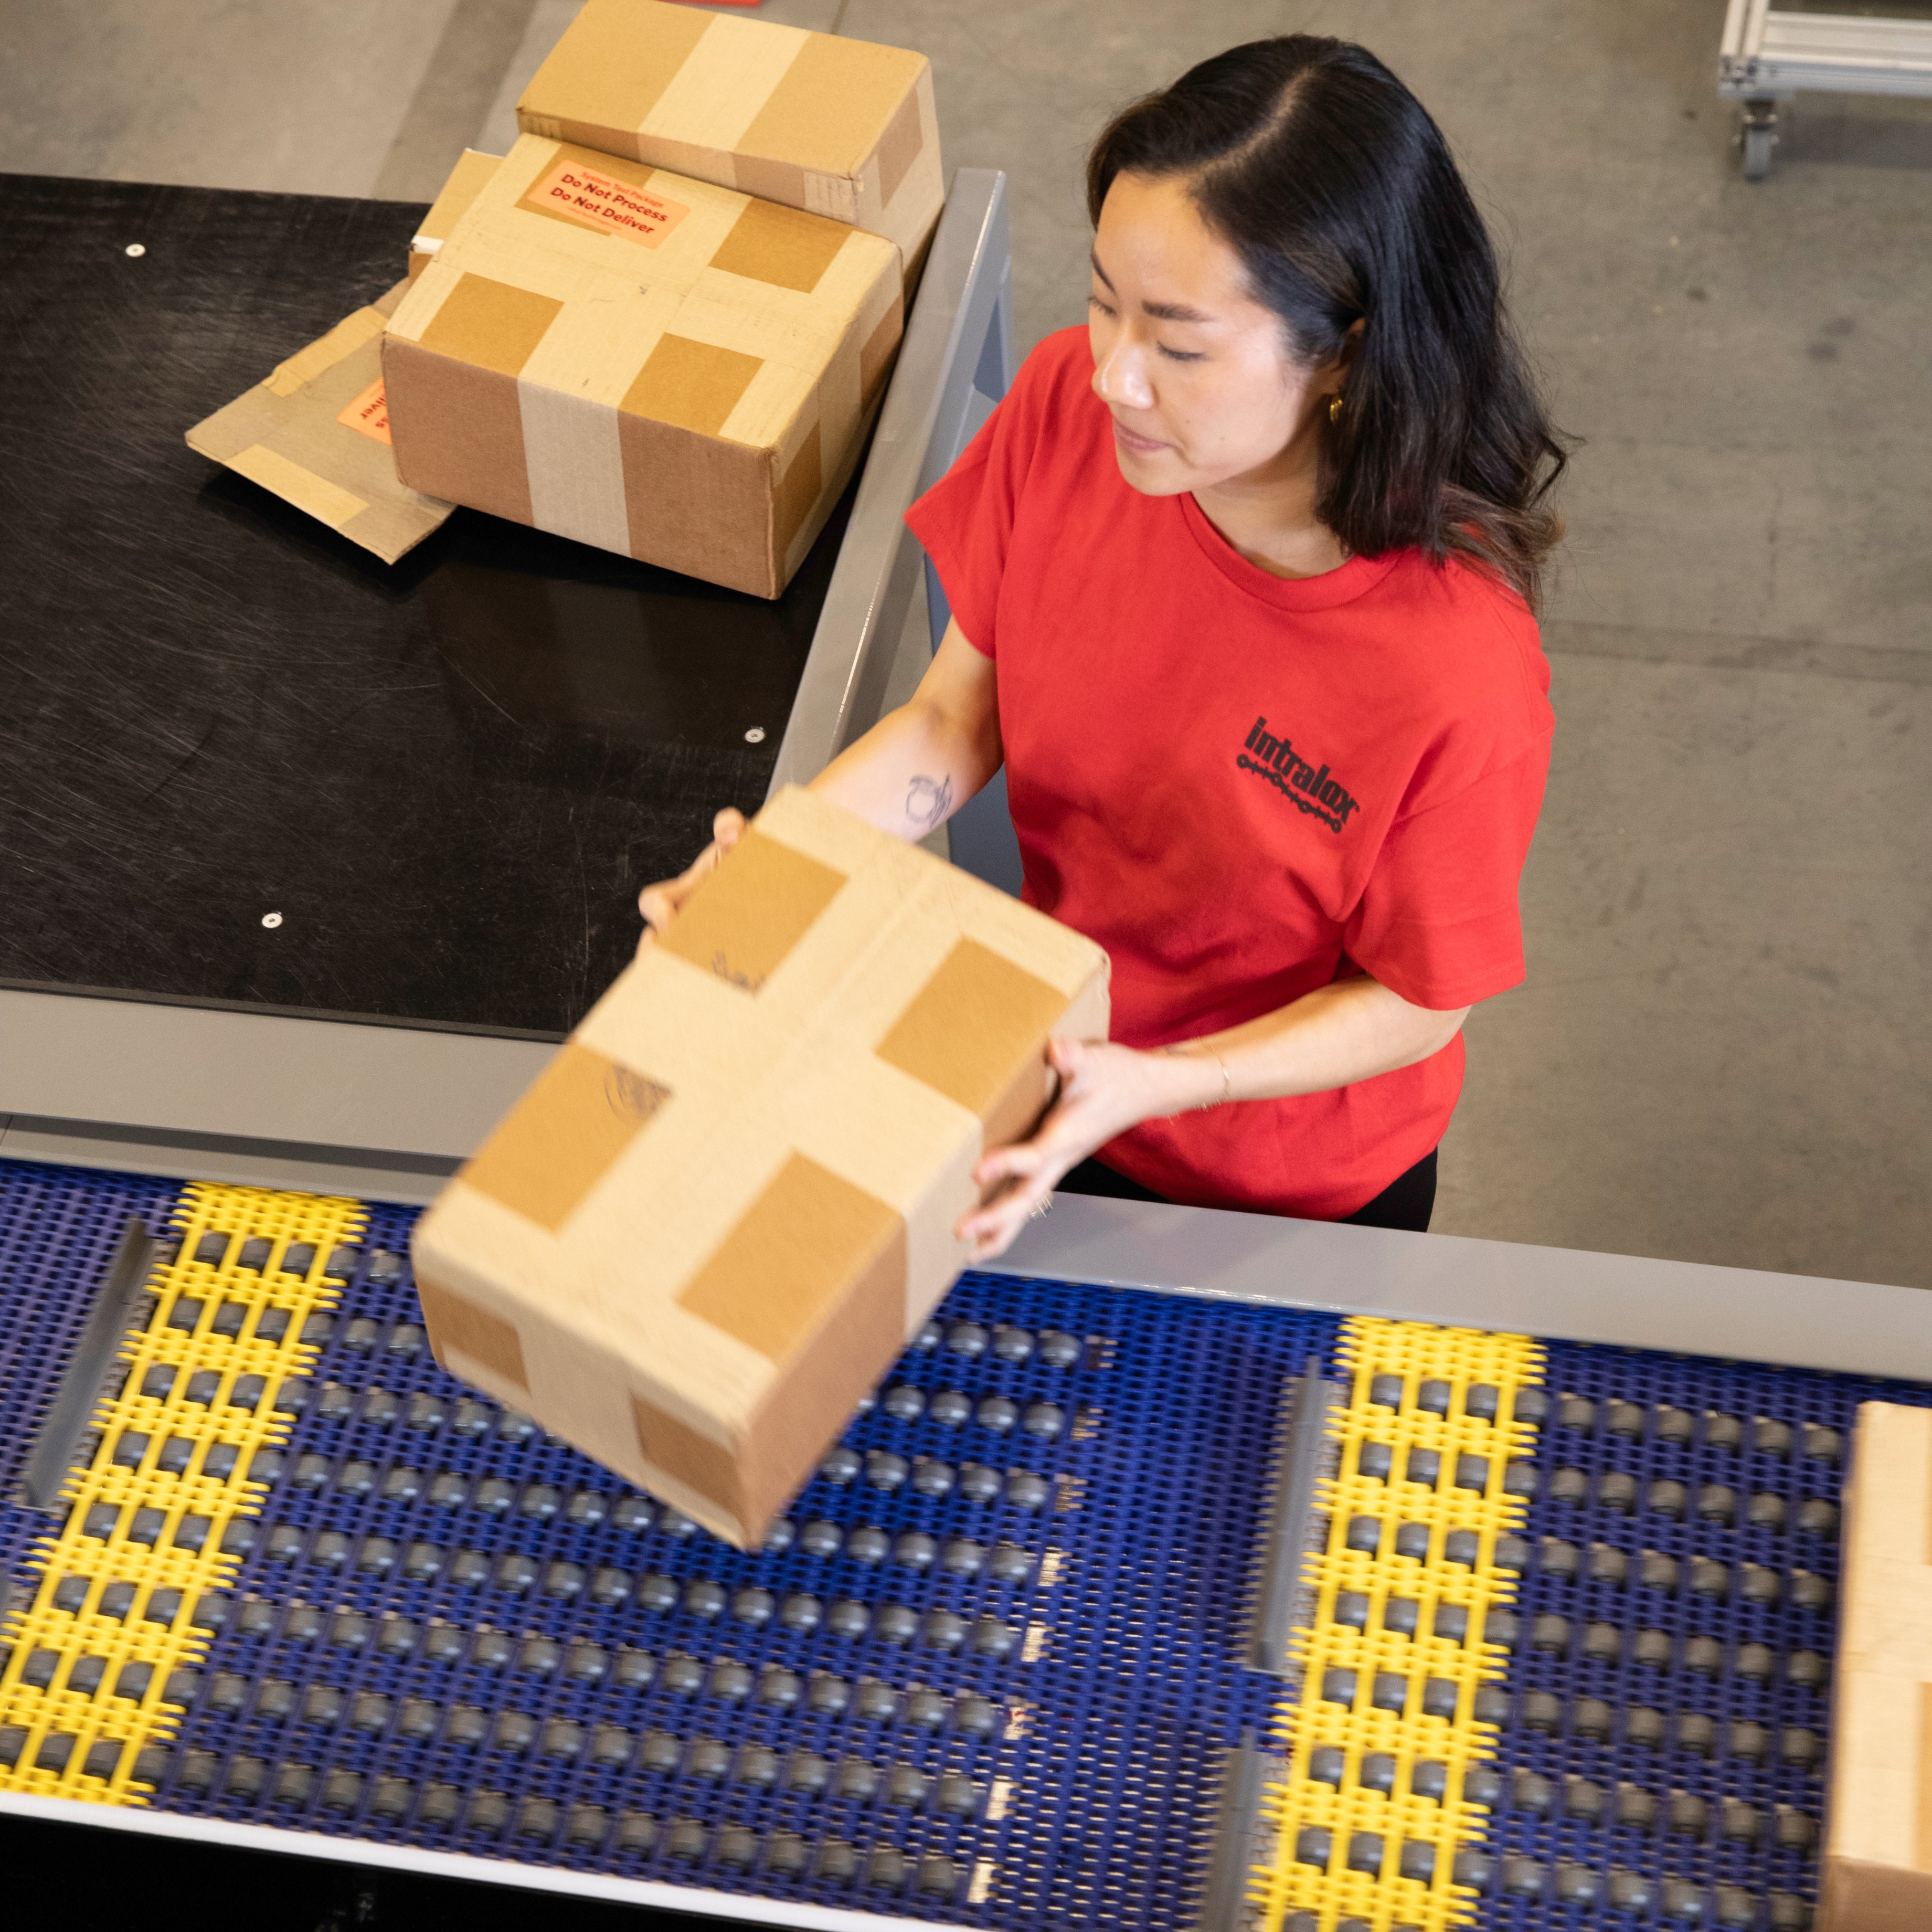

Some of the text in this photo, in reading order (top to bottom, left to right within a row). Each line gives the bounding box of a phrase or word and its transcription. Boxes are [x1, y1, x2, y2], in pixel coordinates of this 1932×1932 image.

[550, 187, 570, 201] Do
[573, 196, 601, 213] Not
[602, 208, 655, 233] Deliver
[561, 174, 581, 187] Do
[584, 183, 611, 199] Not
[612, 194, 668, 222] Process
[1244, 715, 1360, 825] intralox
